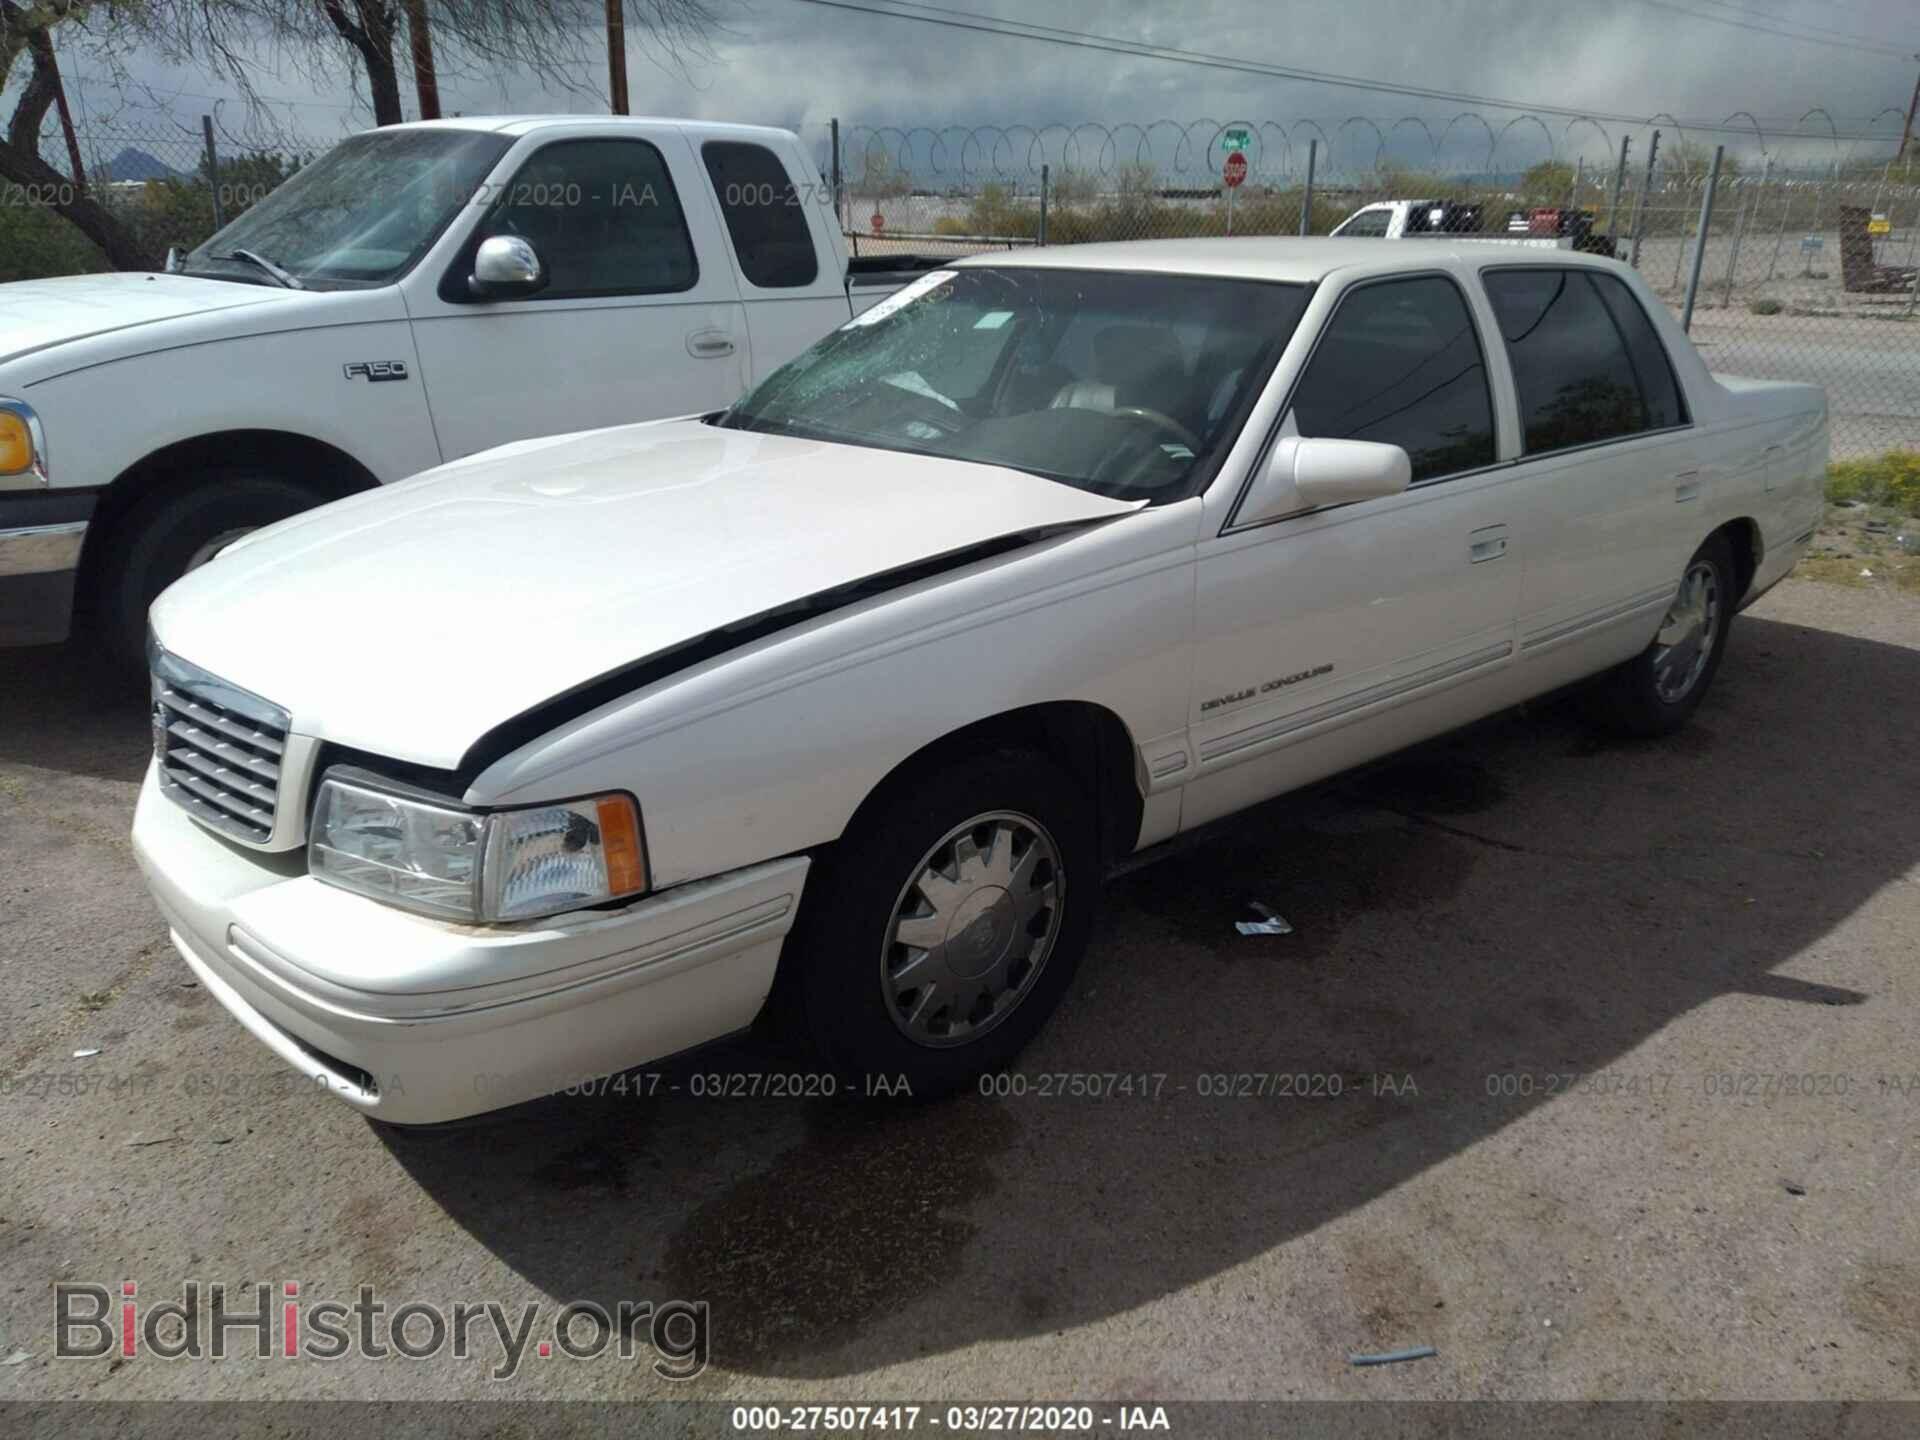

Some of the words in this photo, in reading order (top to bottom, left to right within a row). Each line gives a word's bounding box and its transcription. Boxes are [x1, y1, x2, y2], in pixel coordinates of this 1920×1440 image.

[1224, 162, 1247, 178] STOP
[1200, 687, 1257, 711] DEVILLE
[1260, 664, 1334, 693] CONCOURS
